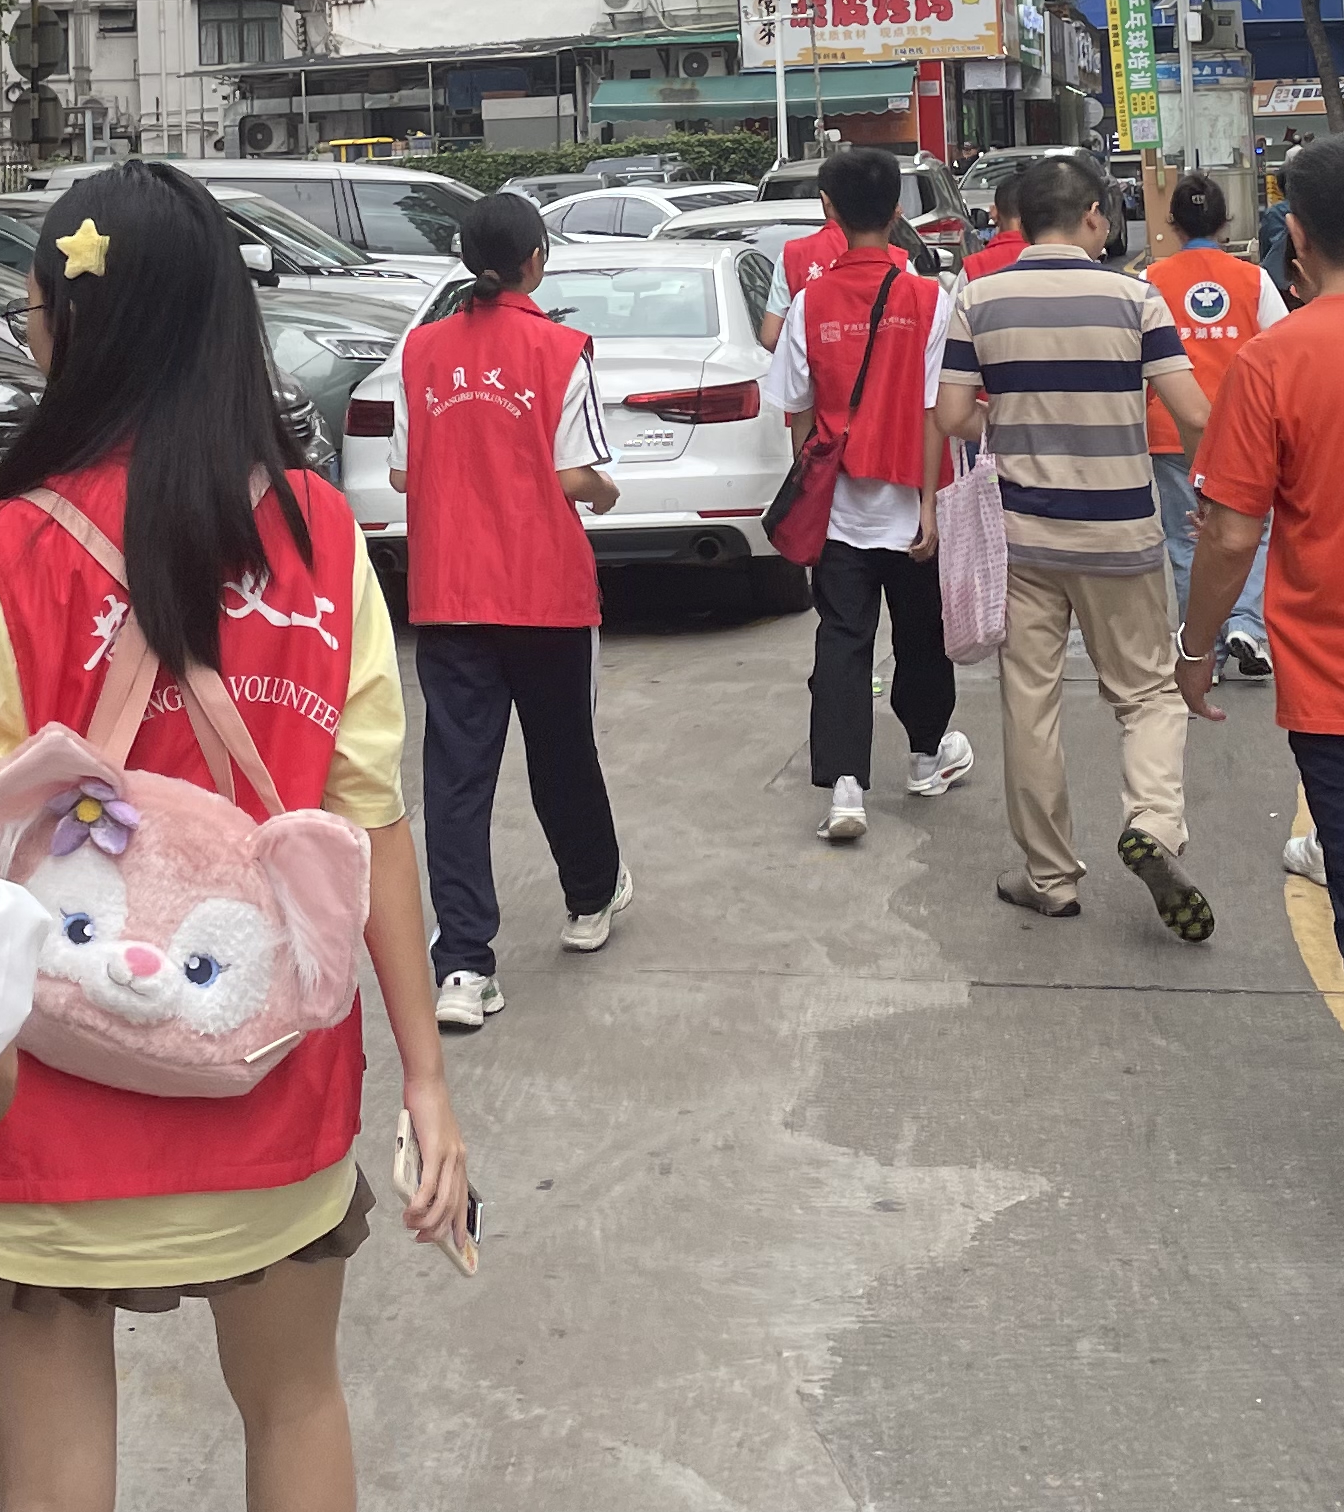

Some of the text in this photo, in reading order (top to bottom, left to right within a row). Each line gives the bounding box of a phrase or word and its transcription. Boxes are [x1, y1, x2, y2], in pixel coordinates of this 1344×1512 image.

[1180, 326, 1239, 340] 罗湖禁毒
[432, 390, 522, 419] HUANGBEI VOLUNTEER
